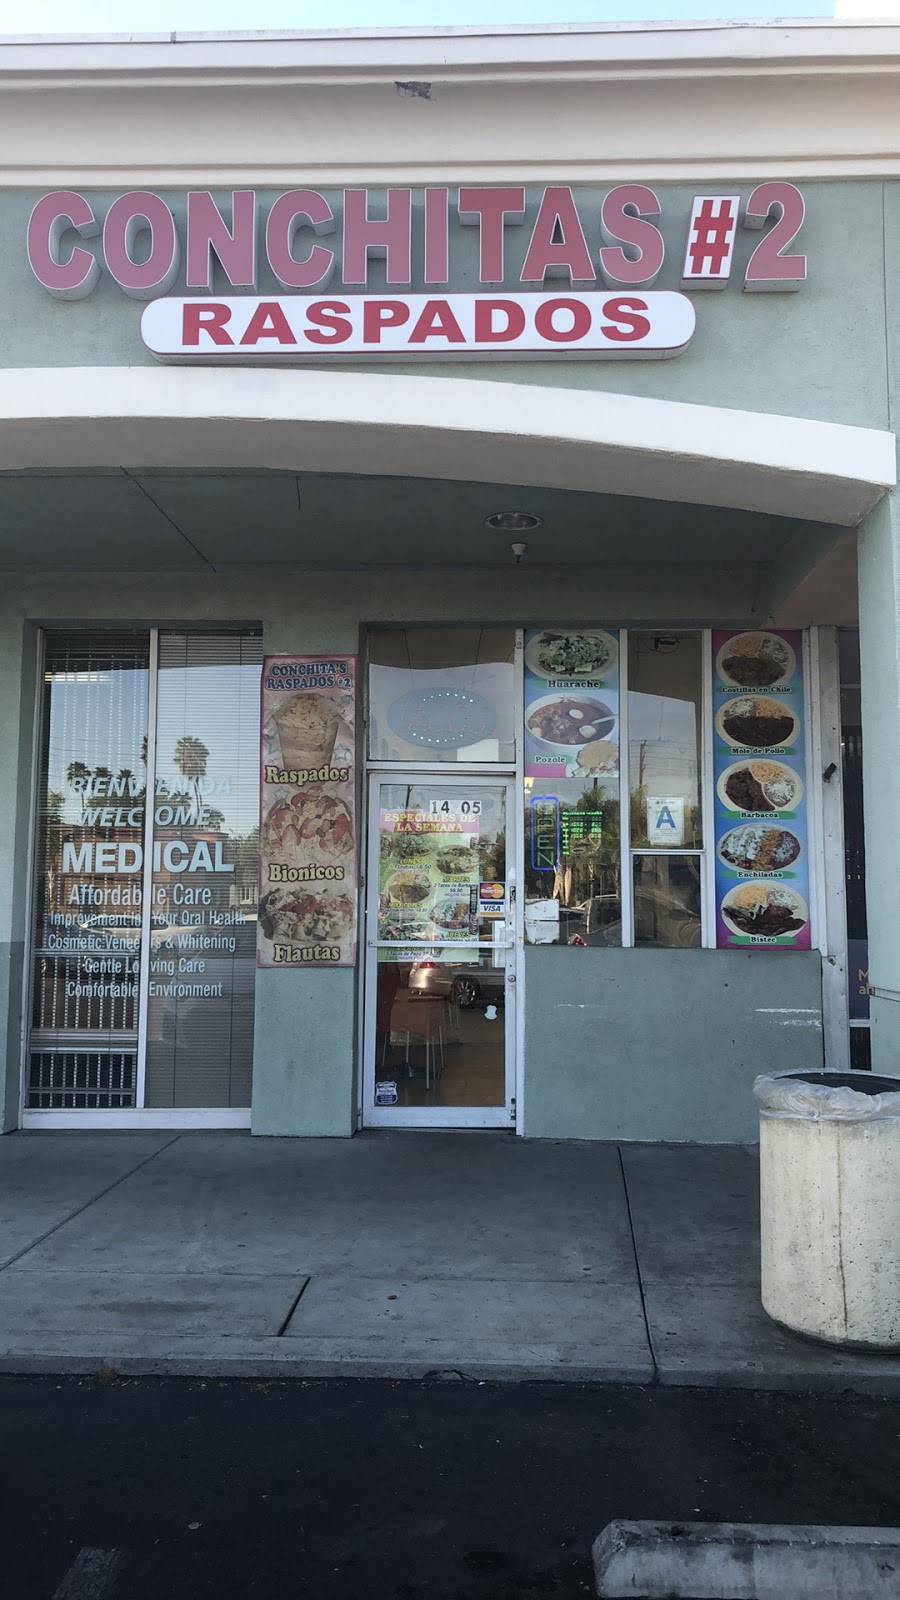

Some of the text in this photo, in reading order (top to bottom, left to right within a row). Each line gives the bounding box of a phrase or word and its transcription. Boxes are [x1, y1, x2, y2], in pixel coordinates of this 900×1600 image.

[27, 183, 665, 290] CONCHITAS
[181, 297, 652, 347] RASPADOS
[271, 662, 347, 676] CONCHITA'S
[266, 675, 334, 689] RASPADOS
[547, 680, 600, 689] Huarache
[264, 764, 349, 787] Raspados
[77, 805, 211, 827] WELCOME
[384, 813, 477, 823] ESPECIALES DE
[656, 806, 676, 829] A
[396, 822, 465, 832] LA SEMANA
[62, 840, 235, 874] MEDICAL
[268, 863, 345, 883] Bionicos
[68, 883, 212, 906] Affordable Care
[50, 911, 127, 928] Improvement
[152, 910, 178, 925] Your
[182, 910, 205, 925] Oral
[209, 910, 246, 925] Health
[48, 934, 102, 950] Cosmetic
[164, 935, 175, 949] &
[177, 934, 237, 953] Whitening
[273, 944, 341, 963] Flautas
[84, 957, 122, 974] Gentle
[178, 957, 206, 973] Care
[67, 981, 224, 998] Comfortable Environment
